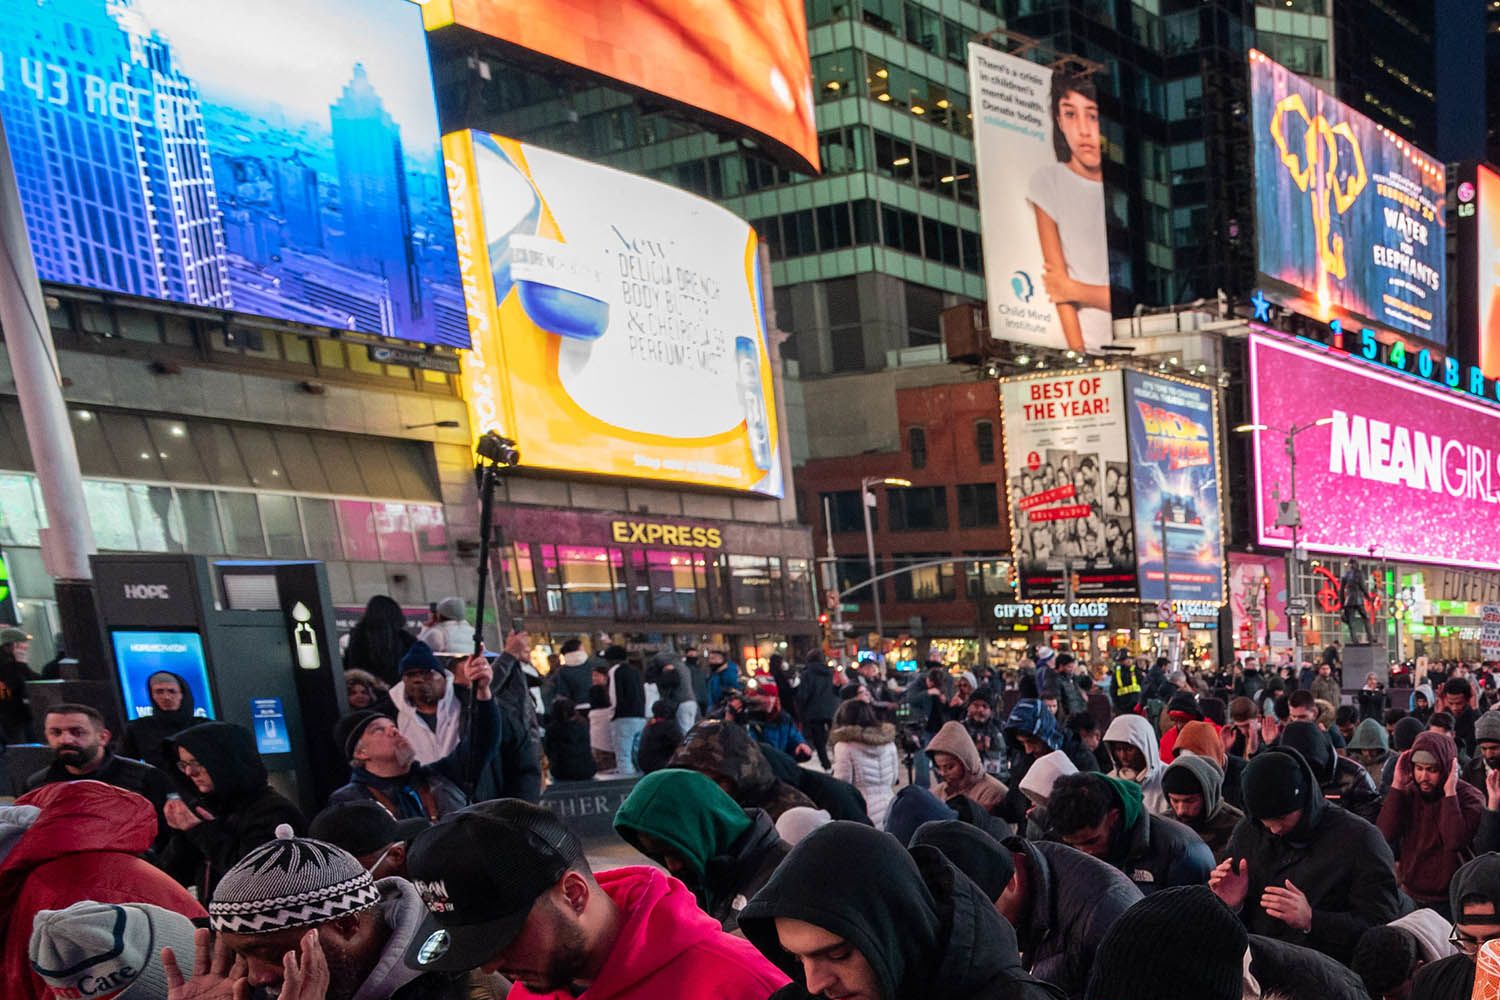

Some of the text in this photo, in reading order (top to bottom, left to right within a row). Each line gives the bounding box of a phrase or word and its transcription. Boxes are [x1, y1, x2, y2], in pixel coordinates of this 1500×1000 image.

[1383, 207, 1429, 246] WATER
[1373, 244, 1440, 291] ELEPHANTS
[998, 303, 1051, 322] Child Mind
[1030, 377, 1102, 401] BEST OF
[1023, 397, 1110, 421] THE YEAR!
[612, 520, 722, 548] EXPRESS
[124, 584, 169, 599] HOPE
[994, 603, 1034, 618] GIFTS
